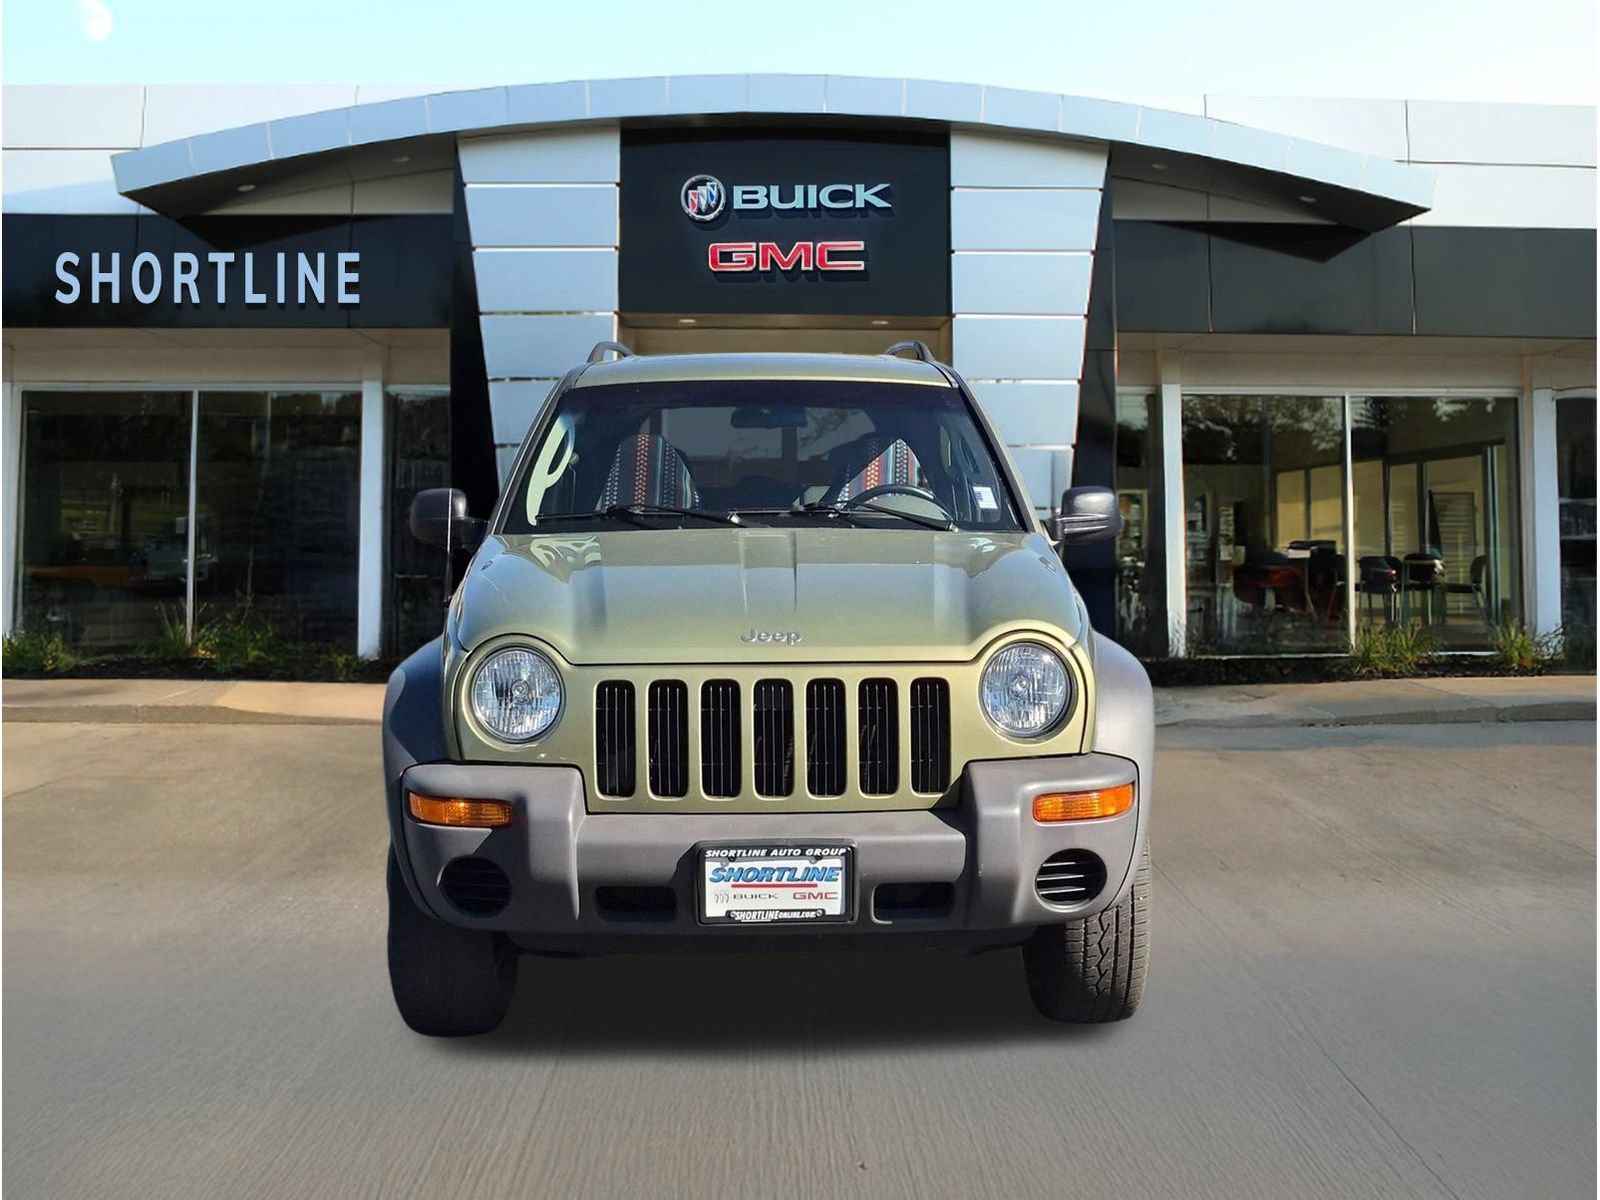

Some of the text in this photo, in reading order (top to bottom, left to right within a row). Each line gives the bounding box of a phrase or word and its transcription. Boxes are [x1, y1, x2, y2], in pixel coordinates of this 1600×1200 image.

[733, 183, 892, 209] BUICK
[708, 241, 865, 271] GMC
[55, 252, 360, 304] SHORTLINE
[741, 628, 802, 645] Jeep
[705, 848, 846, 858] SHORTLINE AUTO GROUP
[709, 866, 843, 883] SHORTLINE
[792, 892, 838, 900] GMC
